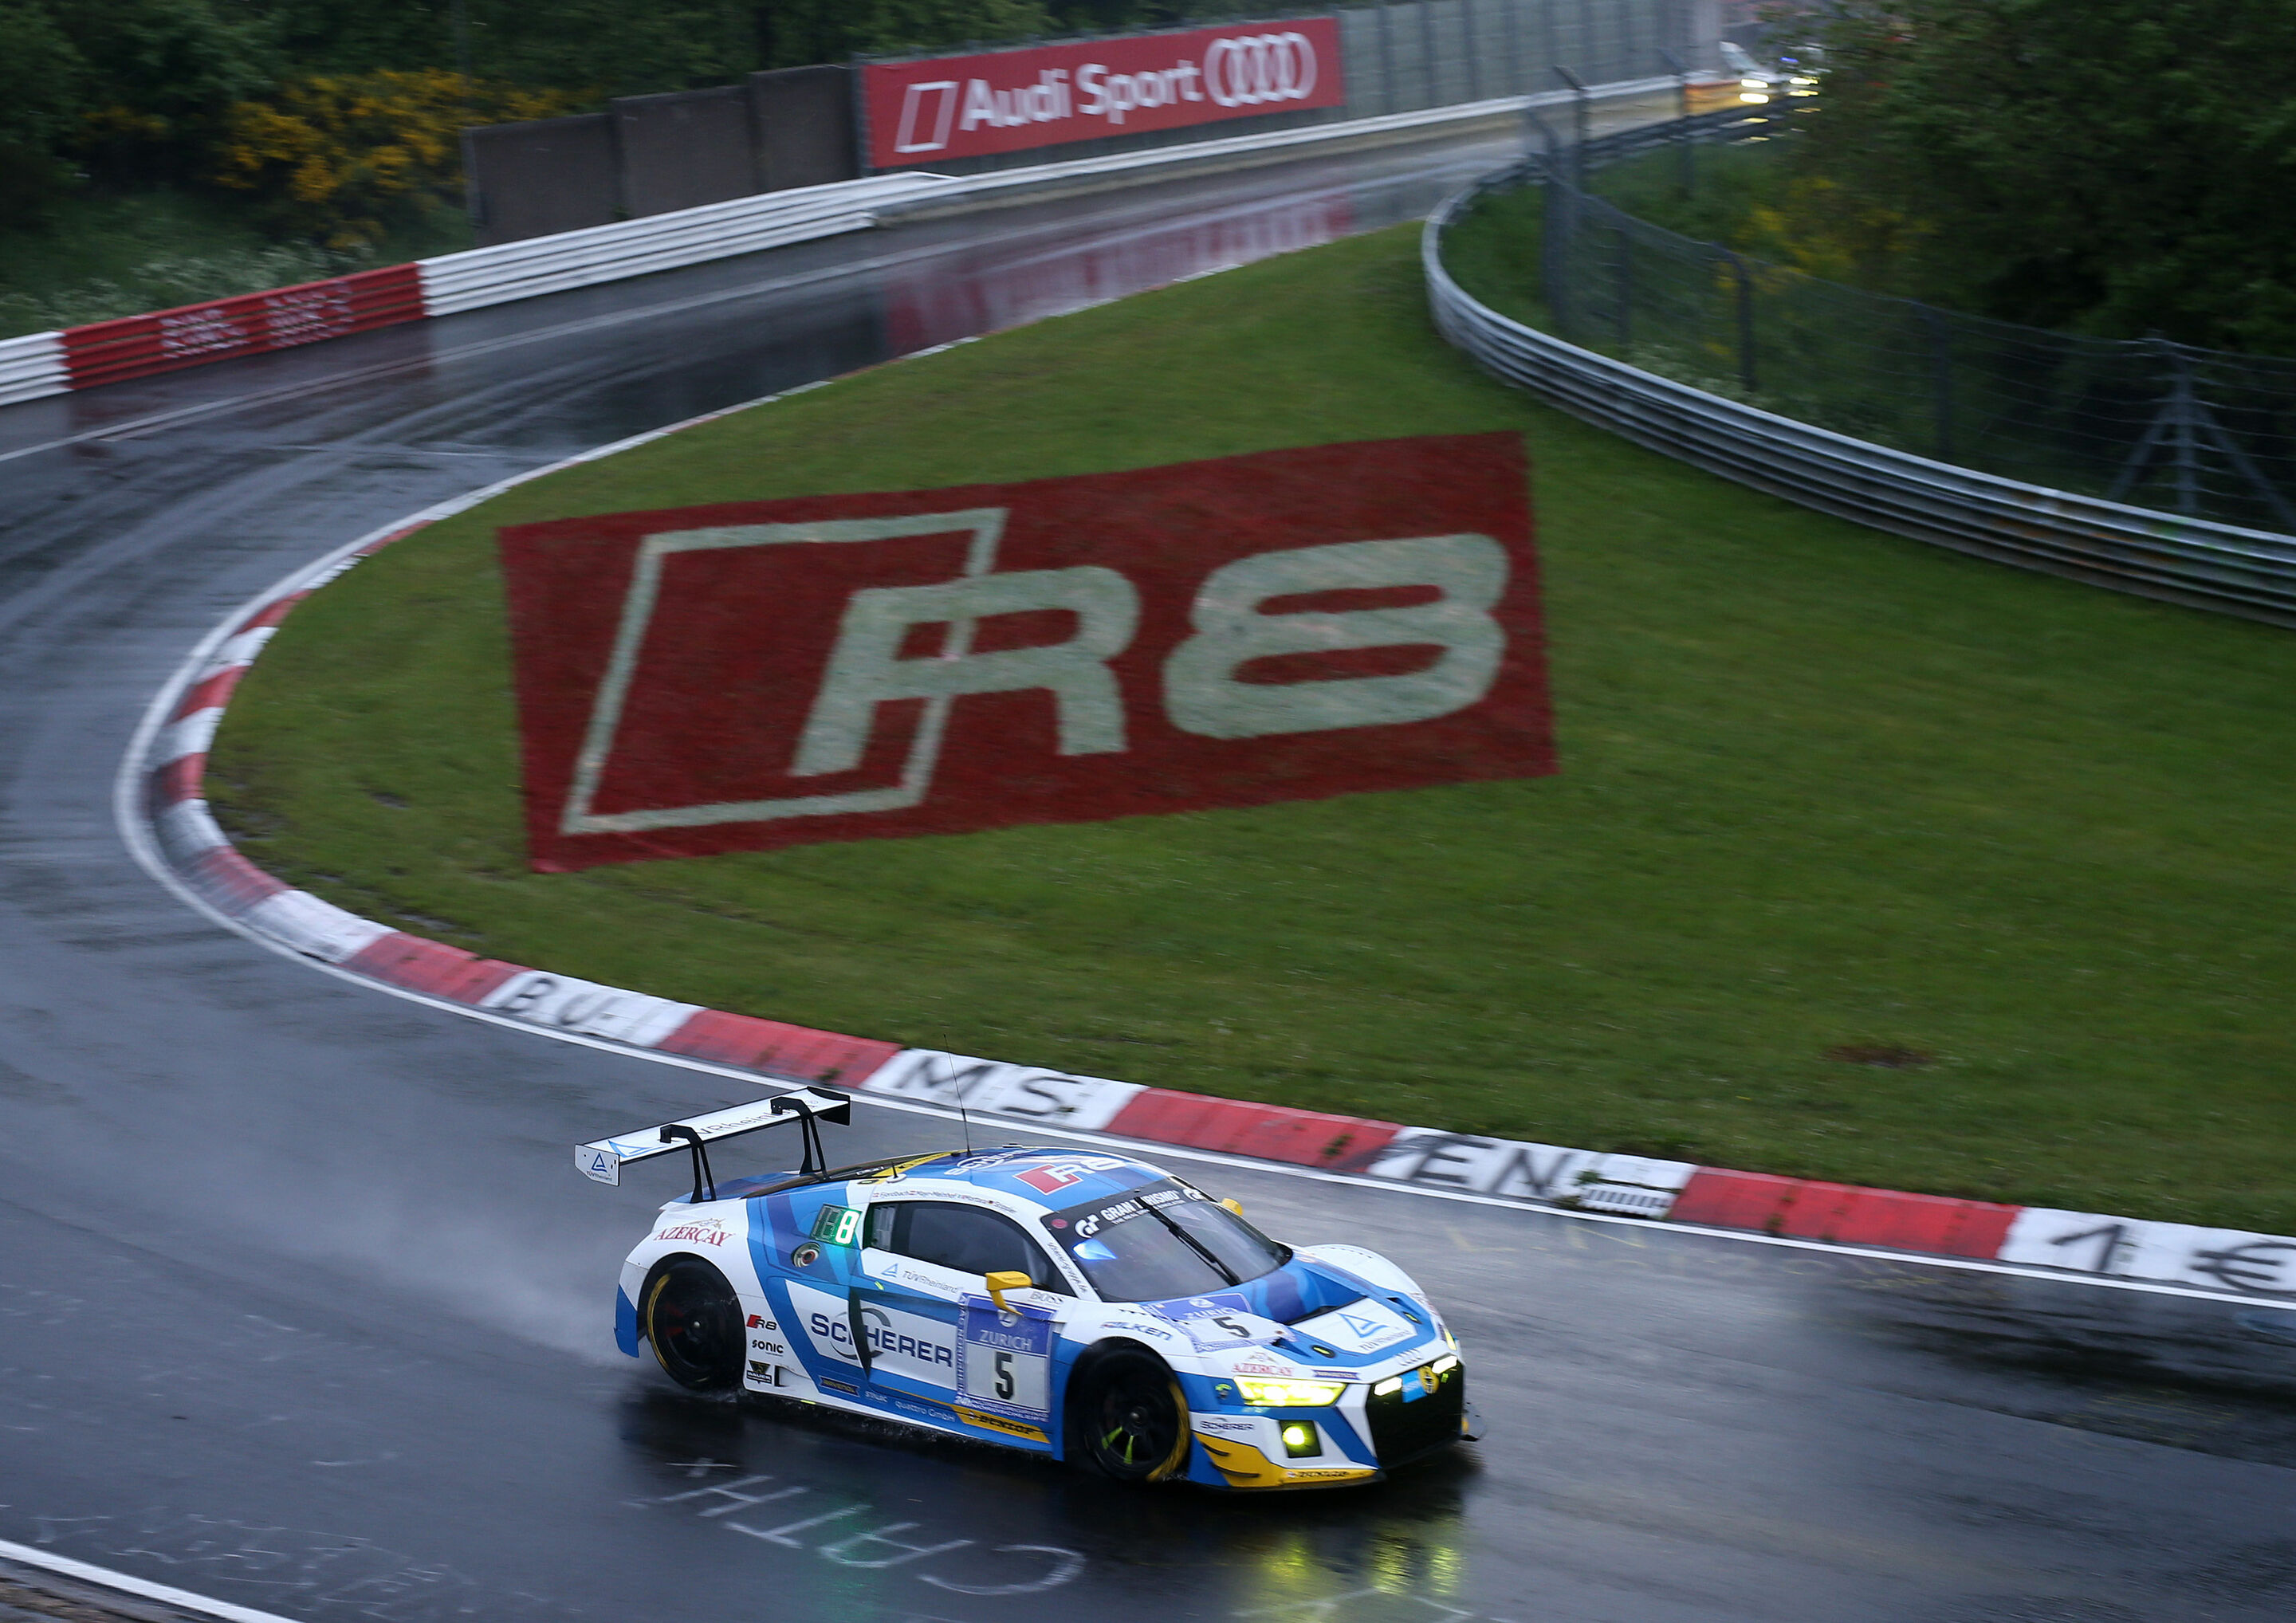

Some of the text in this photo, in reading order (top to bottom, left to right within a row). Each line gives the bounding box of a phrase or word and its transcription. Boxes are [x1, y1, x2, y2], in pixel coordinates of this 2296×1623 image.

[959, 60, 1204, 132] Audi Sport
[789, 531, 1510, 778] R8
[1100, 1200, 1136, 1222] GRAN
[653, 1226, 733, 1247] AZERÇAY
[835, 1210, 860, 1244] 8
[755, 1318, 777, 1330] R8
[1213, 1316, 1252, 1338] 5
[811, 1312, 953, 1368] SCHERER
[978, 1329, 1033, 1351] ZURICH
[995, 1351, 1013, 1400] 5
[894, 1401, 956, 1422] quattro GmbH
[1200, 1421, 1254, 1431] SCHERER
